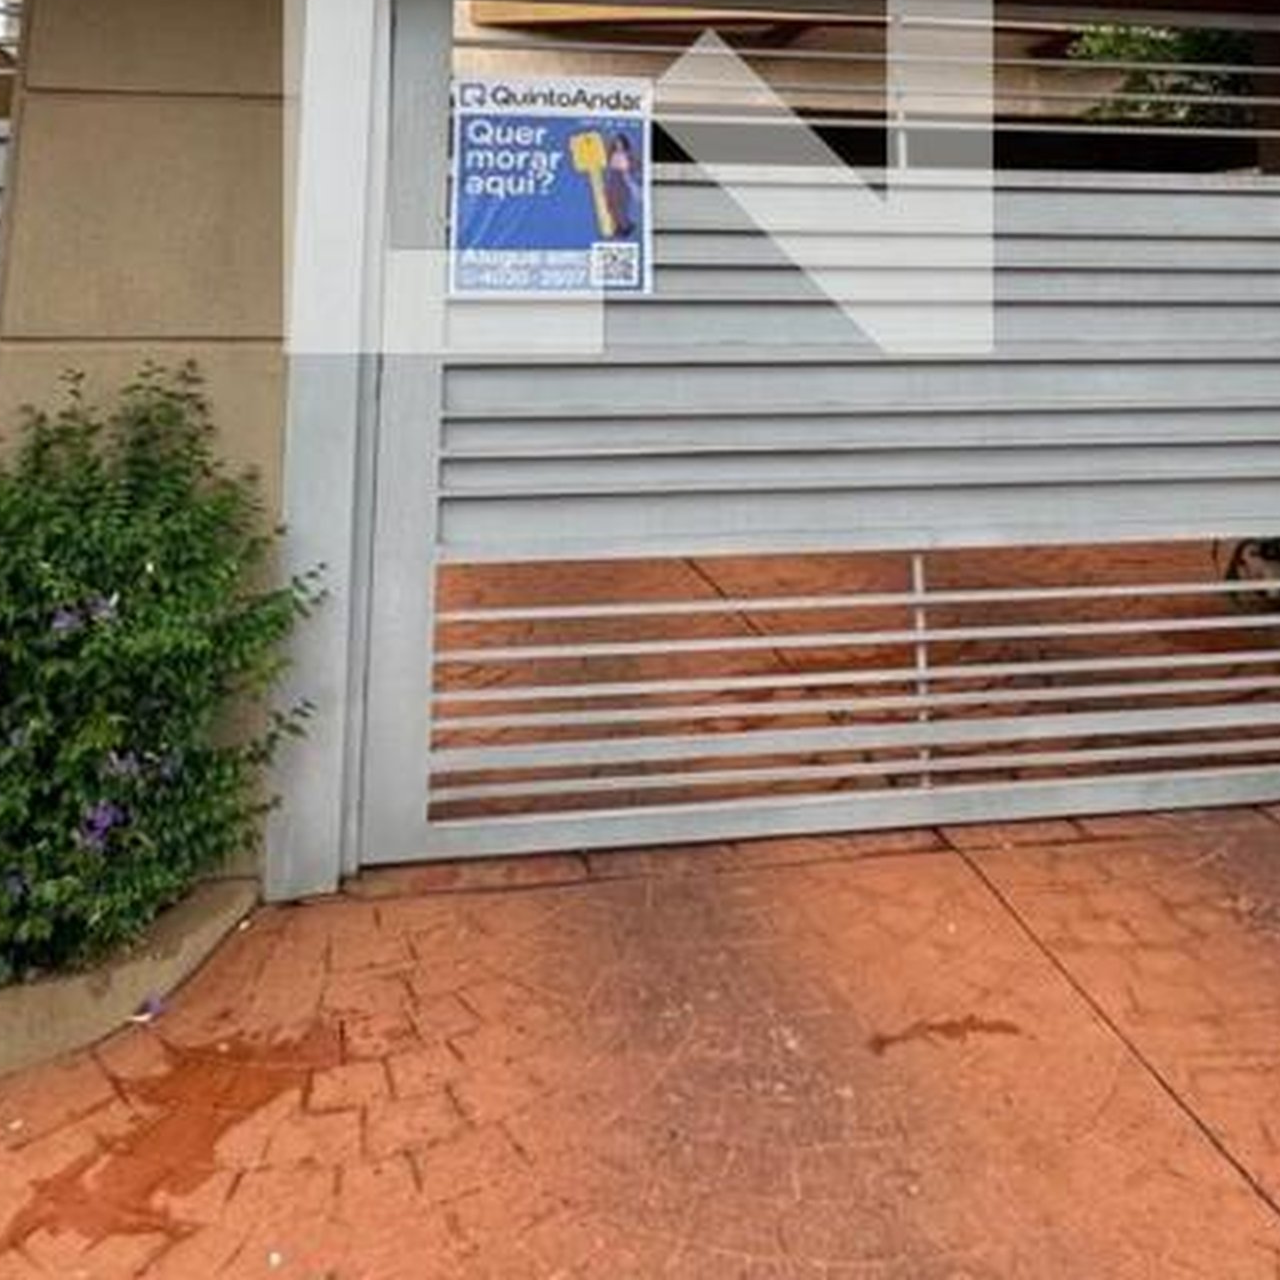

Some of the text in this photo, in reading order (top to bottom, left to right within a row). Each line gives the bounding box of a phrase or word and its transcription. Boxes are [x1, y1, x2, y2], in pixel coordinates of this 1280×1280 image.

[467, 120, 548, 145] Quer
[465, 150, 563, 170] morar
[465, 172, 554, 199] aqui?
